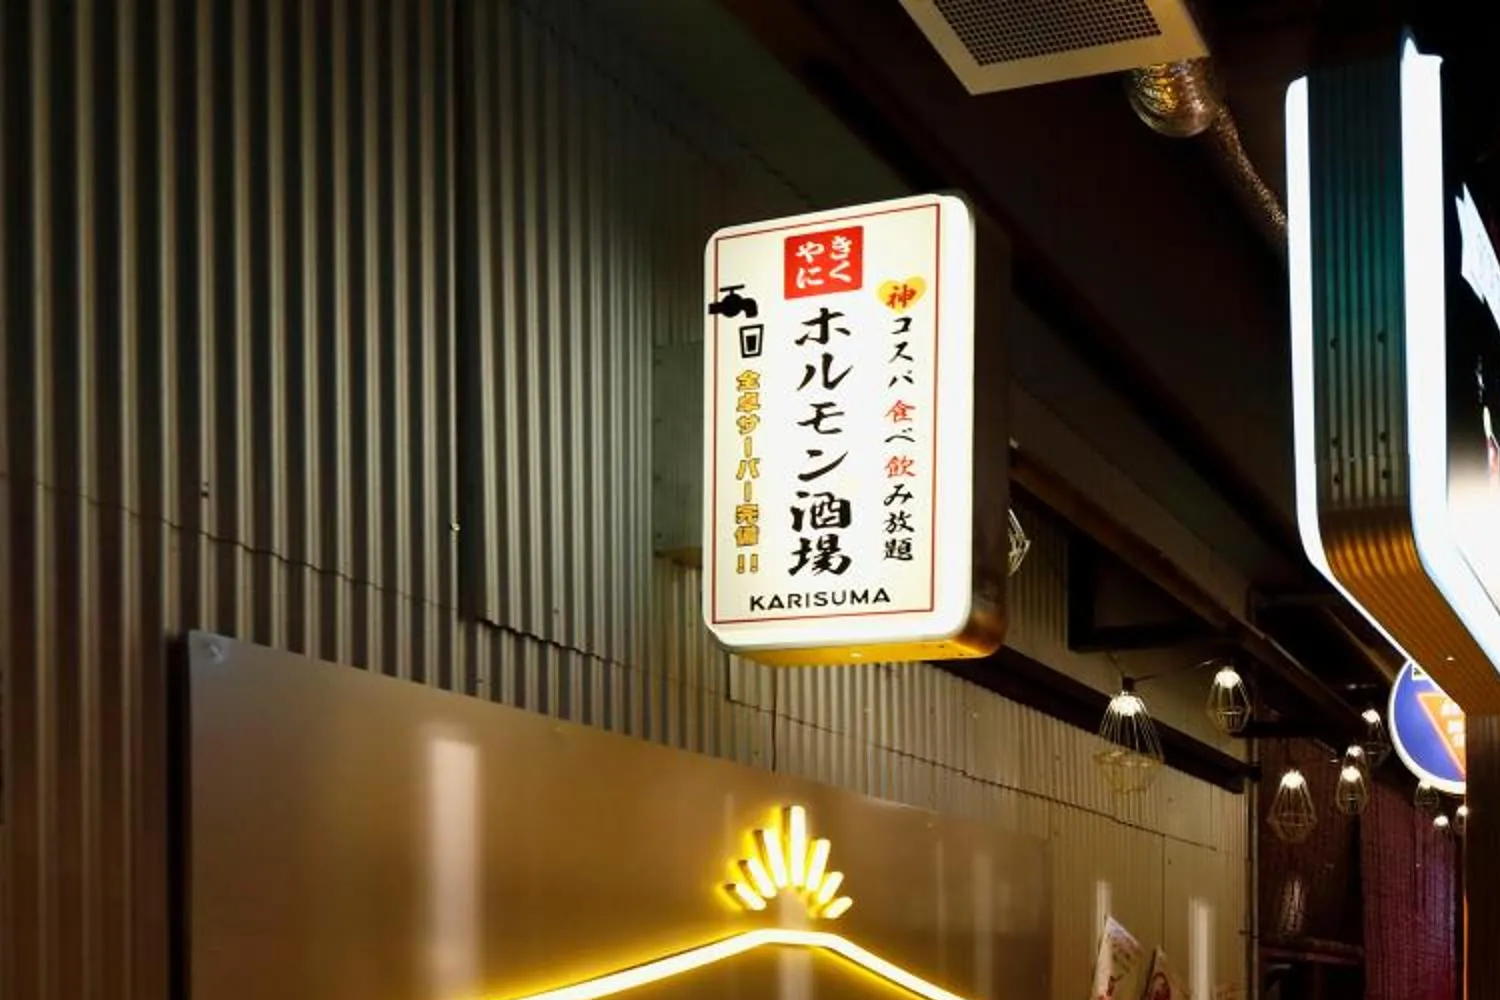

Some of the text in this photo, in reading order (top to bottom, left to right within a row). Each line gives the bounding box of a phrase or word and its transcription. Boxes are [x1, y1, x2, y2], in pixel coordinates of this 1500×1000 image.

[795, 235, 853, 264] やき
[795, 260, 853, 289] にく
[788, 306, 853, 577] ホルモン酒場
[749, 587, 891, 612] KARISUMA
